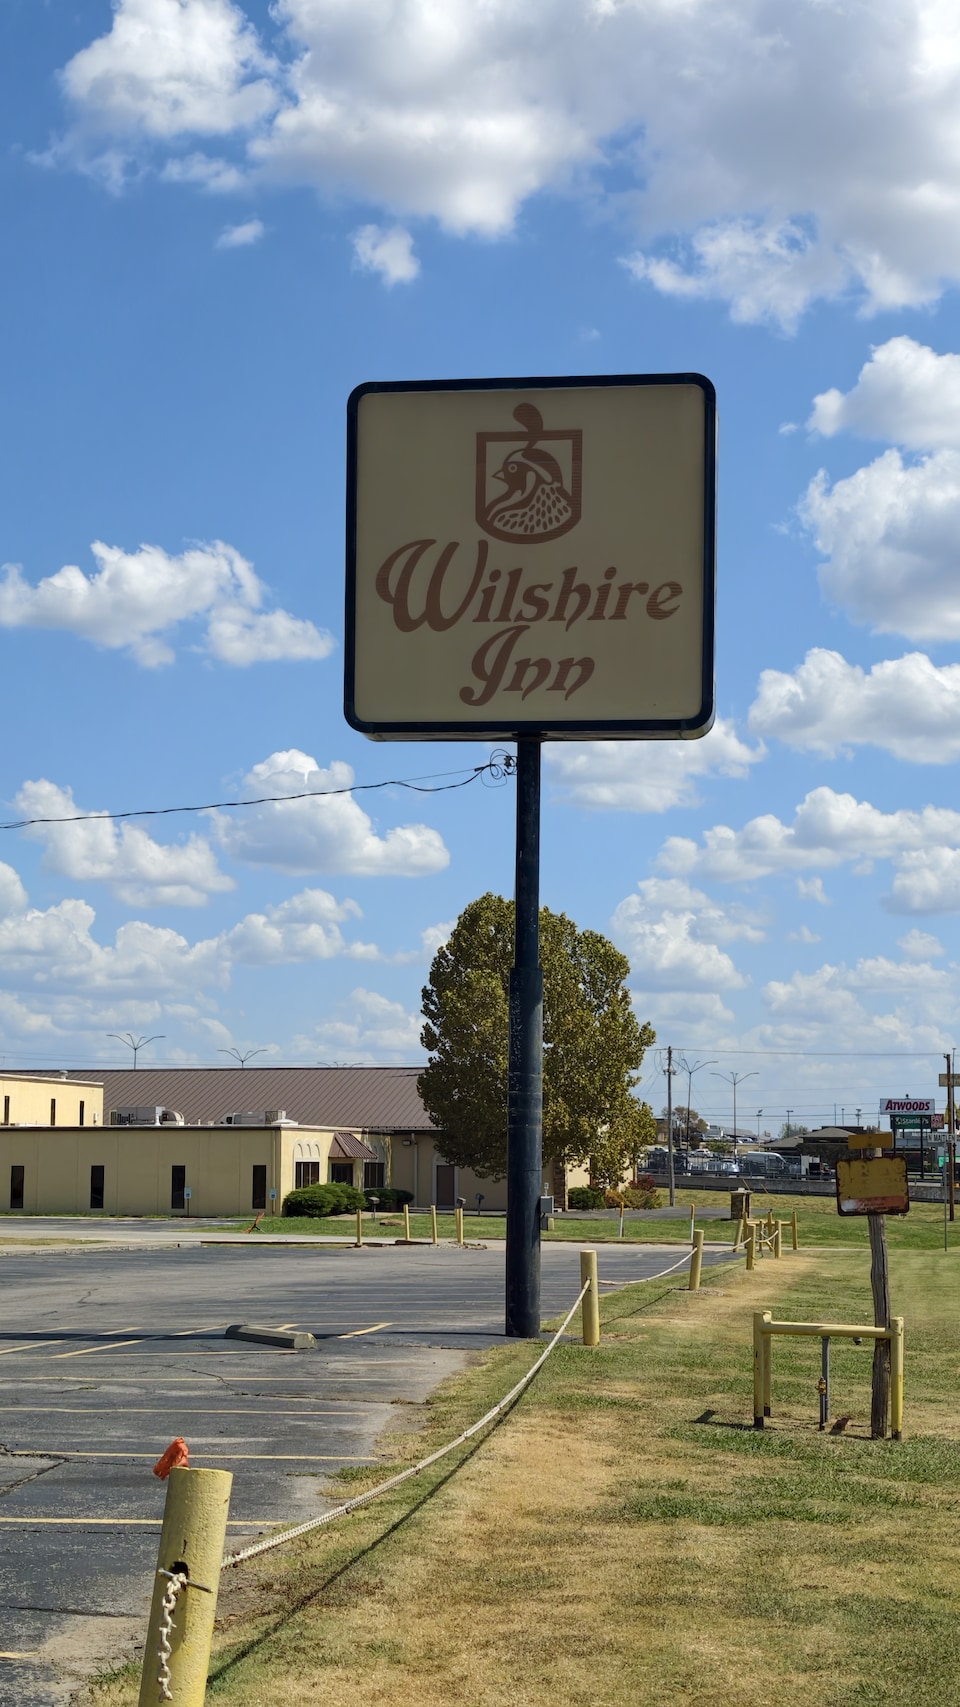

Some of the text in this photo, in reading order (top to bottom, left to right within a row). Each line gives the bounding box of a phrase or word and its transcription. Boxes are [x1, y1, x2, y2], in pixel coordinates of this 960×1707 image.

[375, 538, 683, 633] Wilshire
[459, 624, 596, 707] Inn
[885, 1099, 931, 1111] ATWOODS
